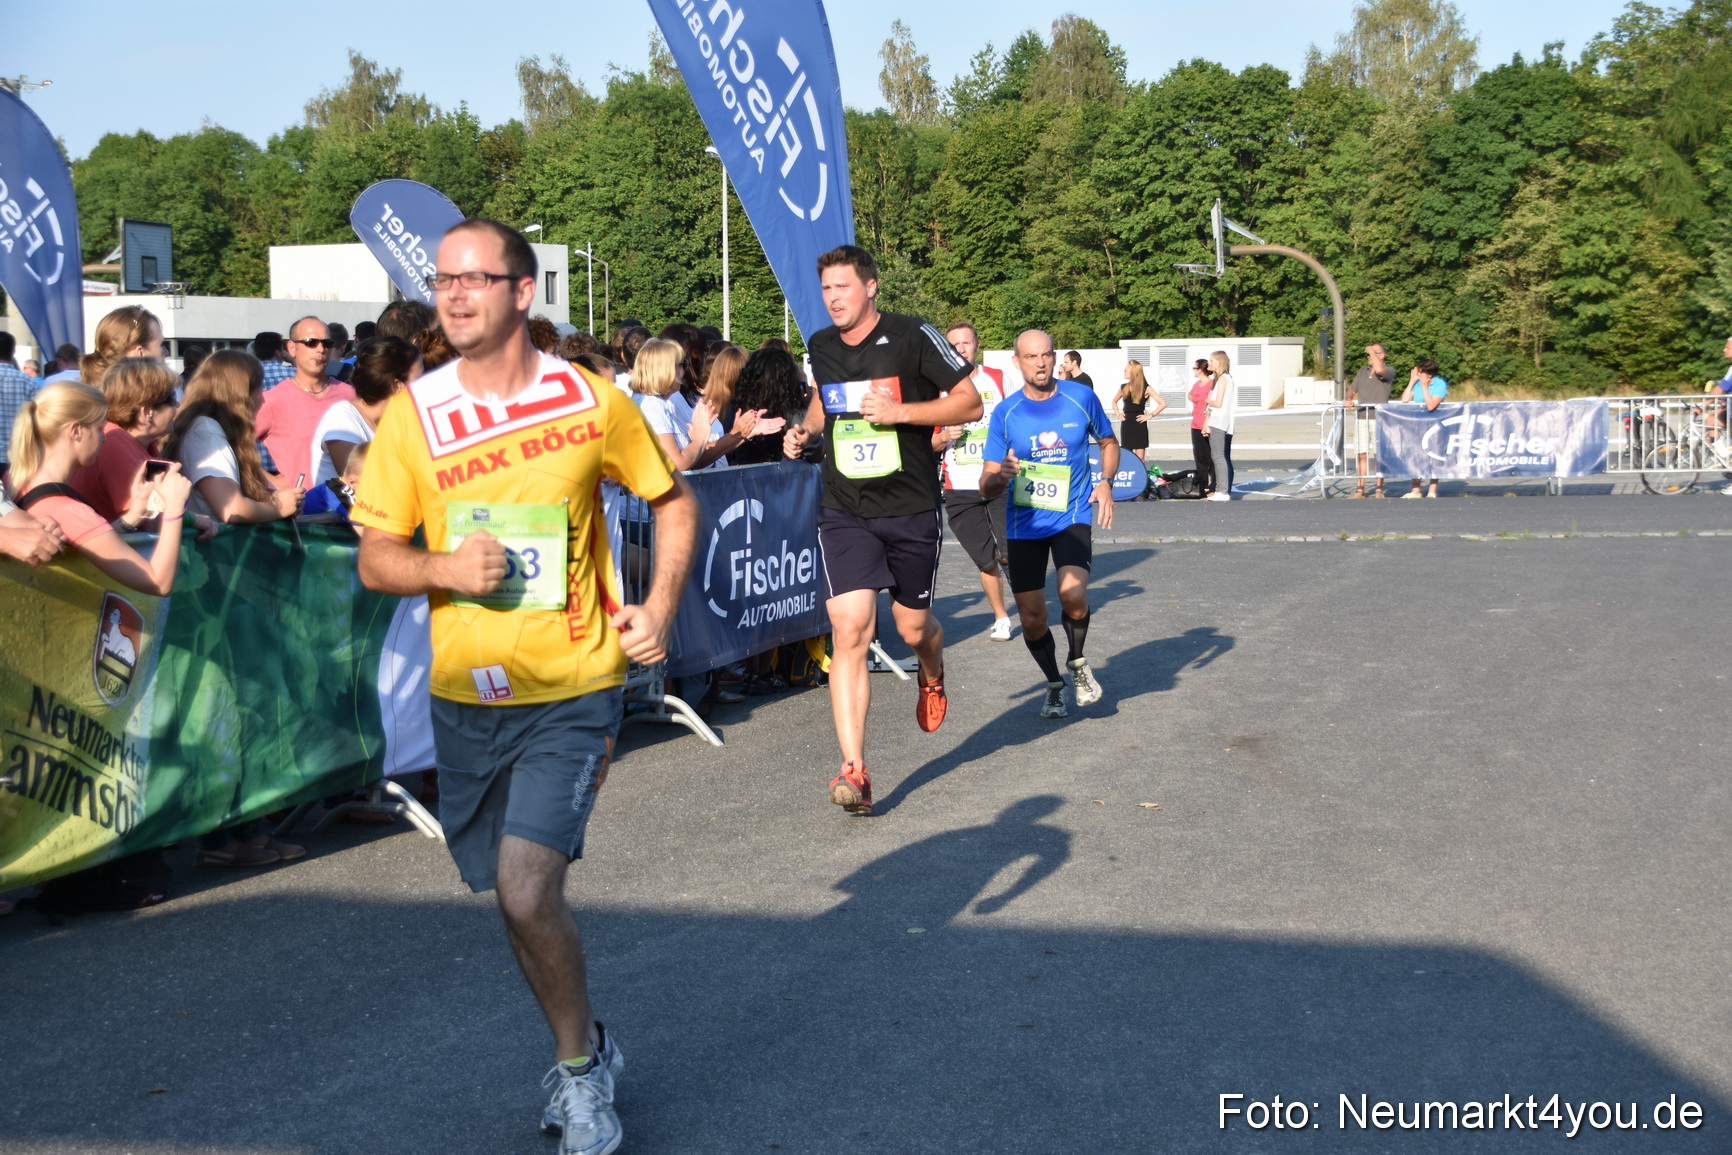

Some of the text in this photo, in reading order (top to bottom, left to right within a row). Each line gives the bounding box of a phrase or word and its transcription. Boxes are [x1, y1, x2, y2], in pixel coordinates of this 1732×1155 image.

[853, 443, 877, 462] 37
[1030, 436, 1038, 451] I
[1031, 448, 1067, 459] camping
[1446, 433, 1559, 455] Fischer
[436, 420, 604, 491] MAX BÖGL
[1456, 456, 1550, 467] AUTOMOBILE
[1025, 480, 1058, 498] 489
[737, 591, 816, 629] AUTOMOBILE
[102, 675, 124, 698] 1628
[572, 754, 597, 810] adidas
